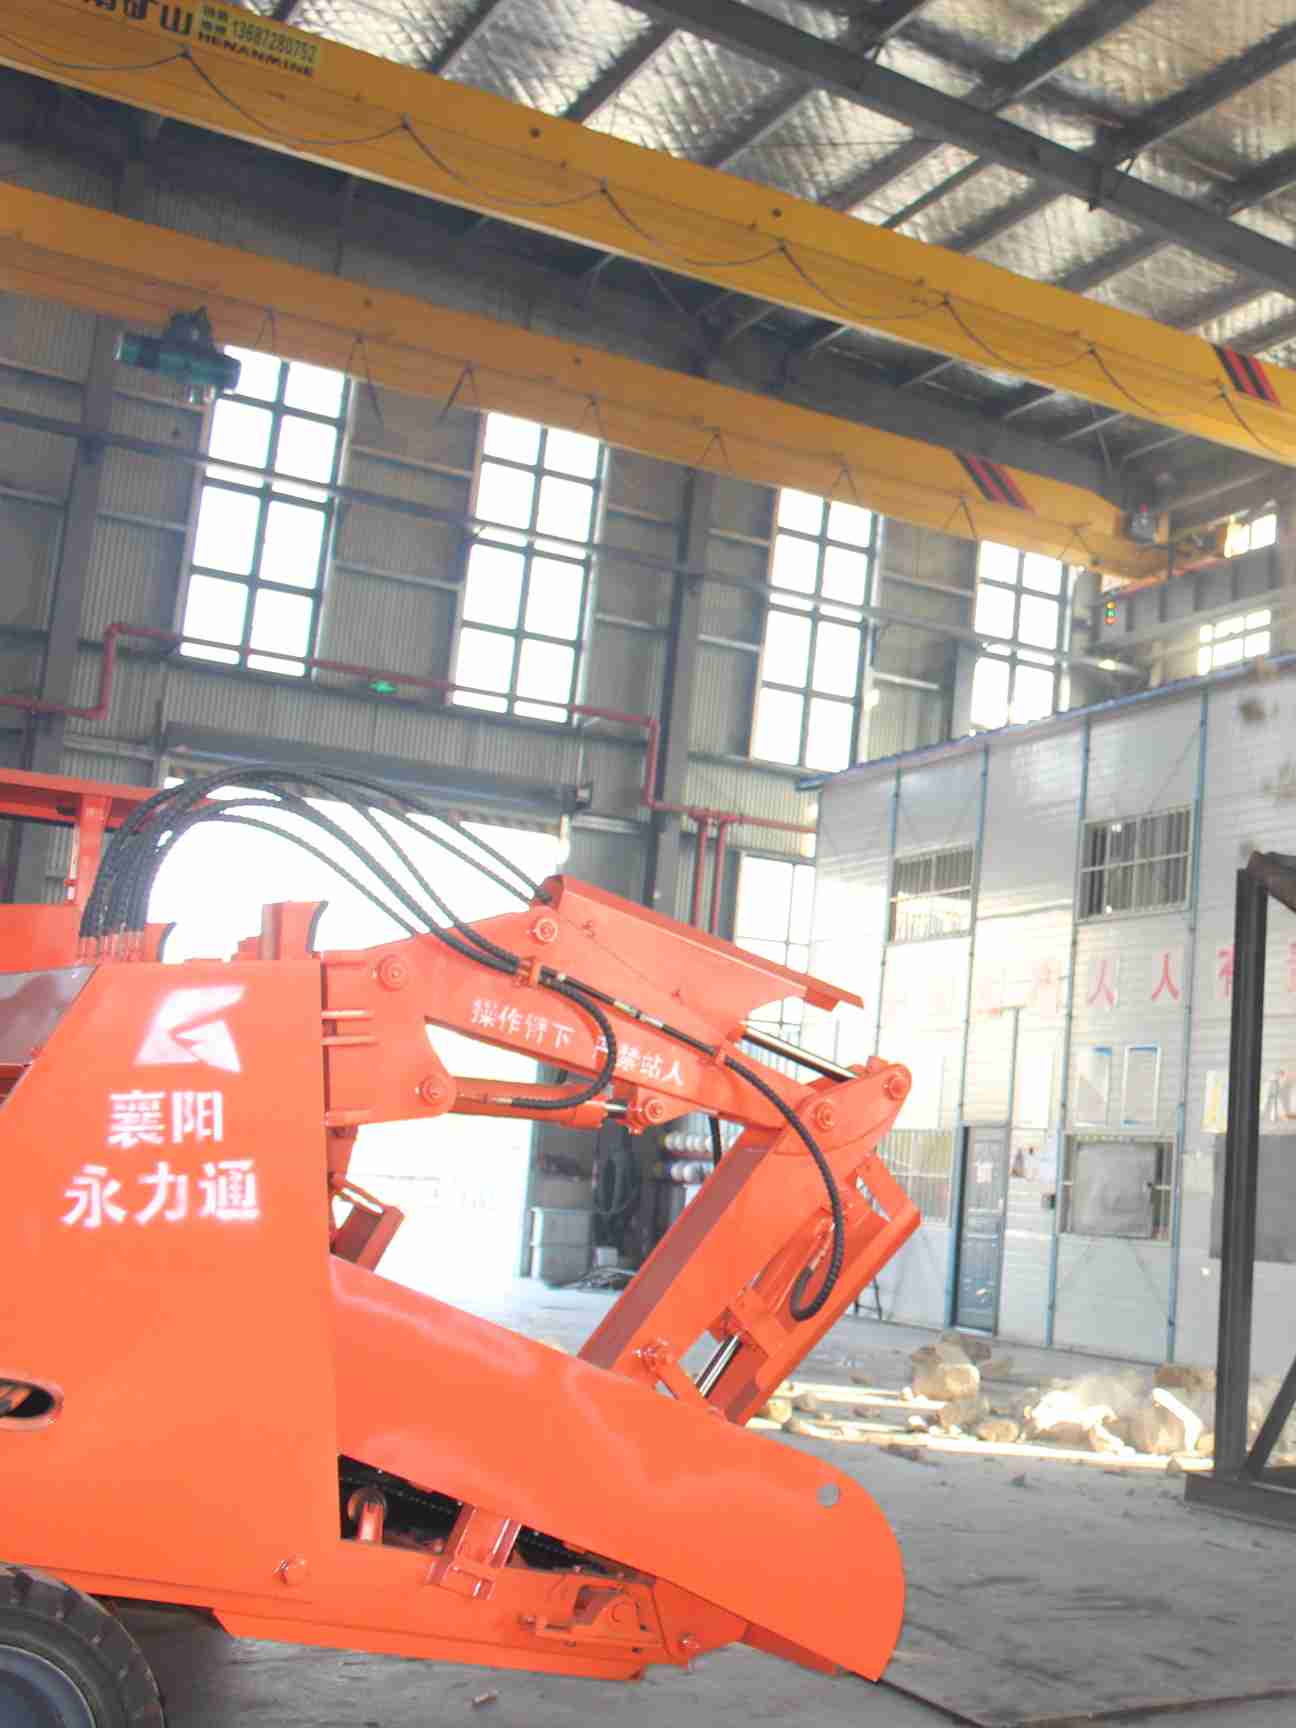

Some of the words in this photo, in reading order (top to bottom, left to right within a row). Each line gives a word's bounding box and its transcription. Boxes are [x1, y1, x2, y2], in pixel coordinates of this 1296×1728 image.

[106, 1089, 224, 1149] 襄阳
[61, 1159, 260, 1229] 永力通
